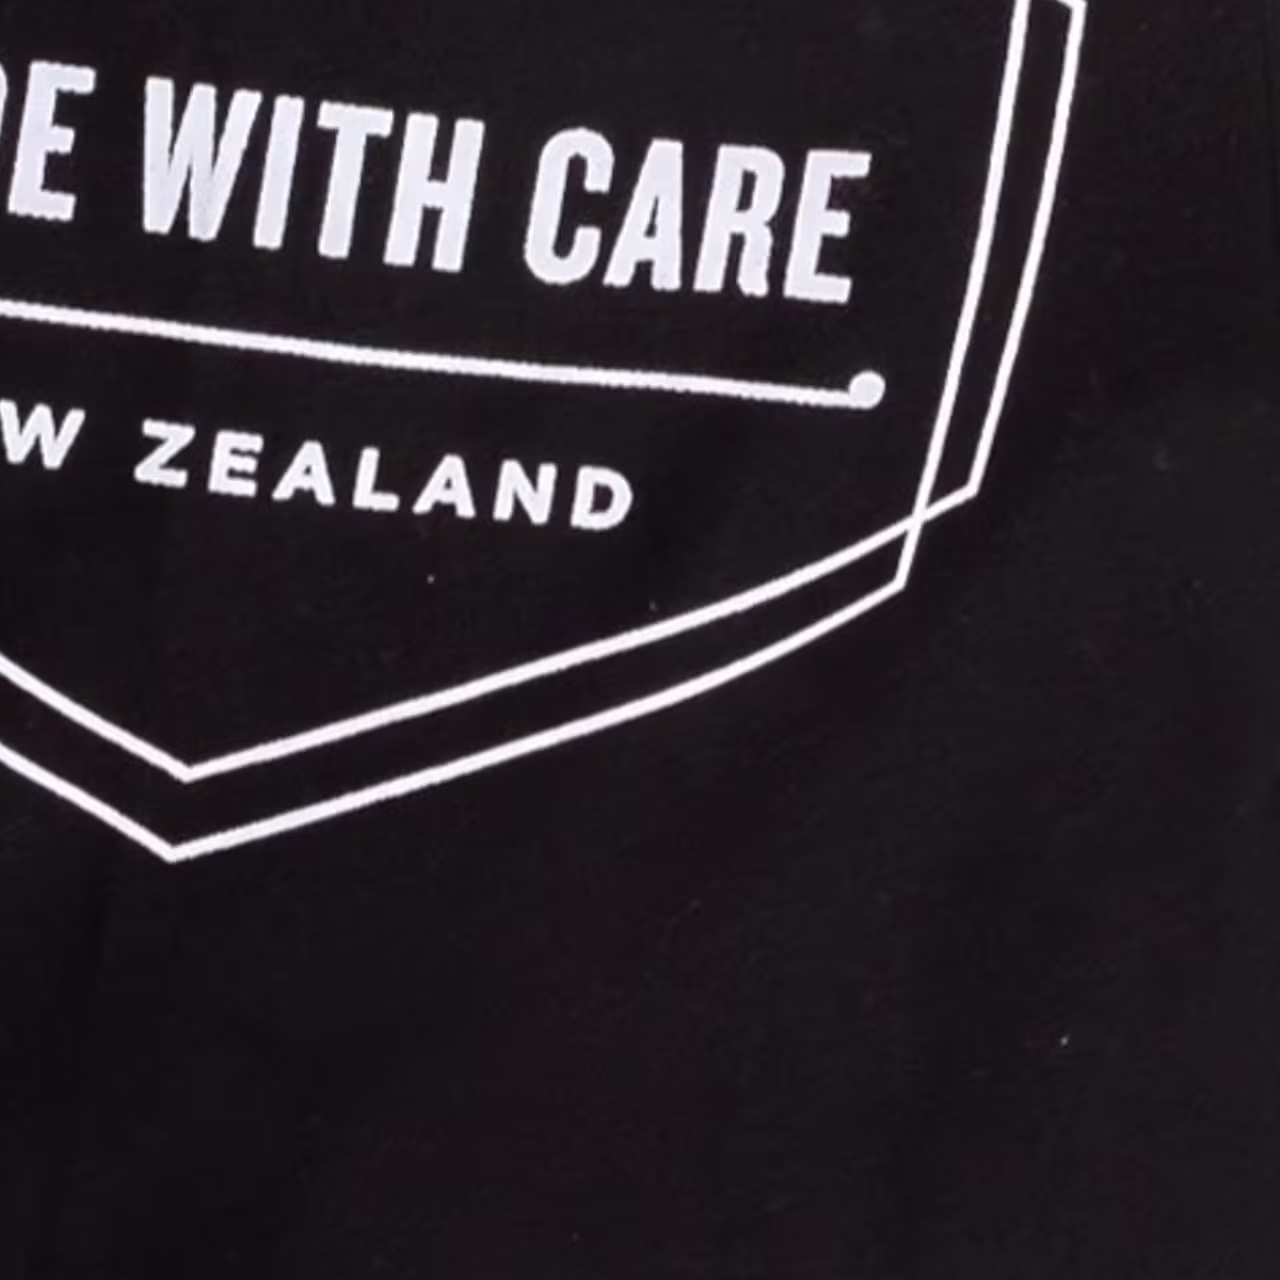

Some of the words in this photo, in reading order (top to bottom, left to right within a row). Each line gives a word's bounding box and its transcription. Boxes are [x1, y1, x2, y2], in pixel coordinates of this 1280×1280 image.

[142, 75, 486, 273] WITH
[523, 126, 873, 305] CARE
[133, 418, 634, 531] ZEALAND
